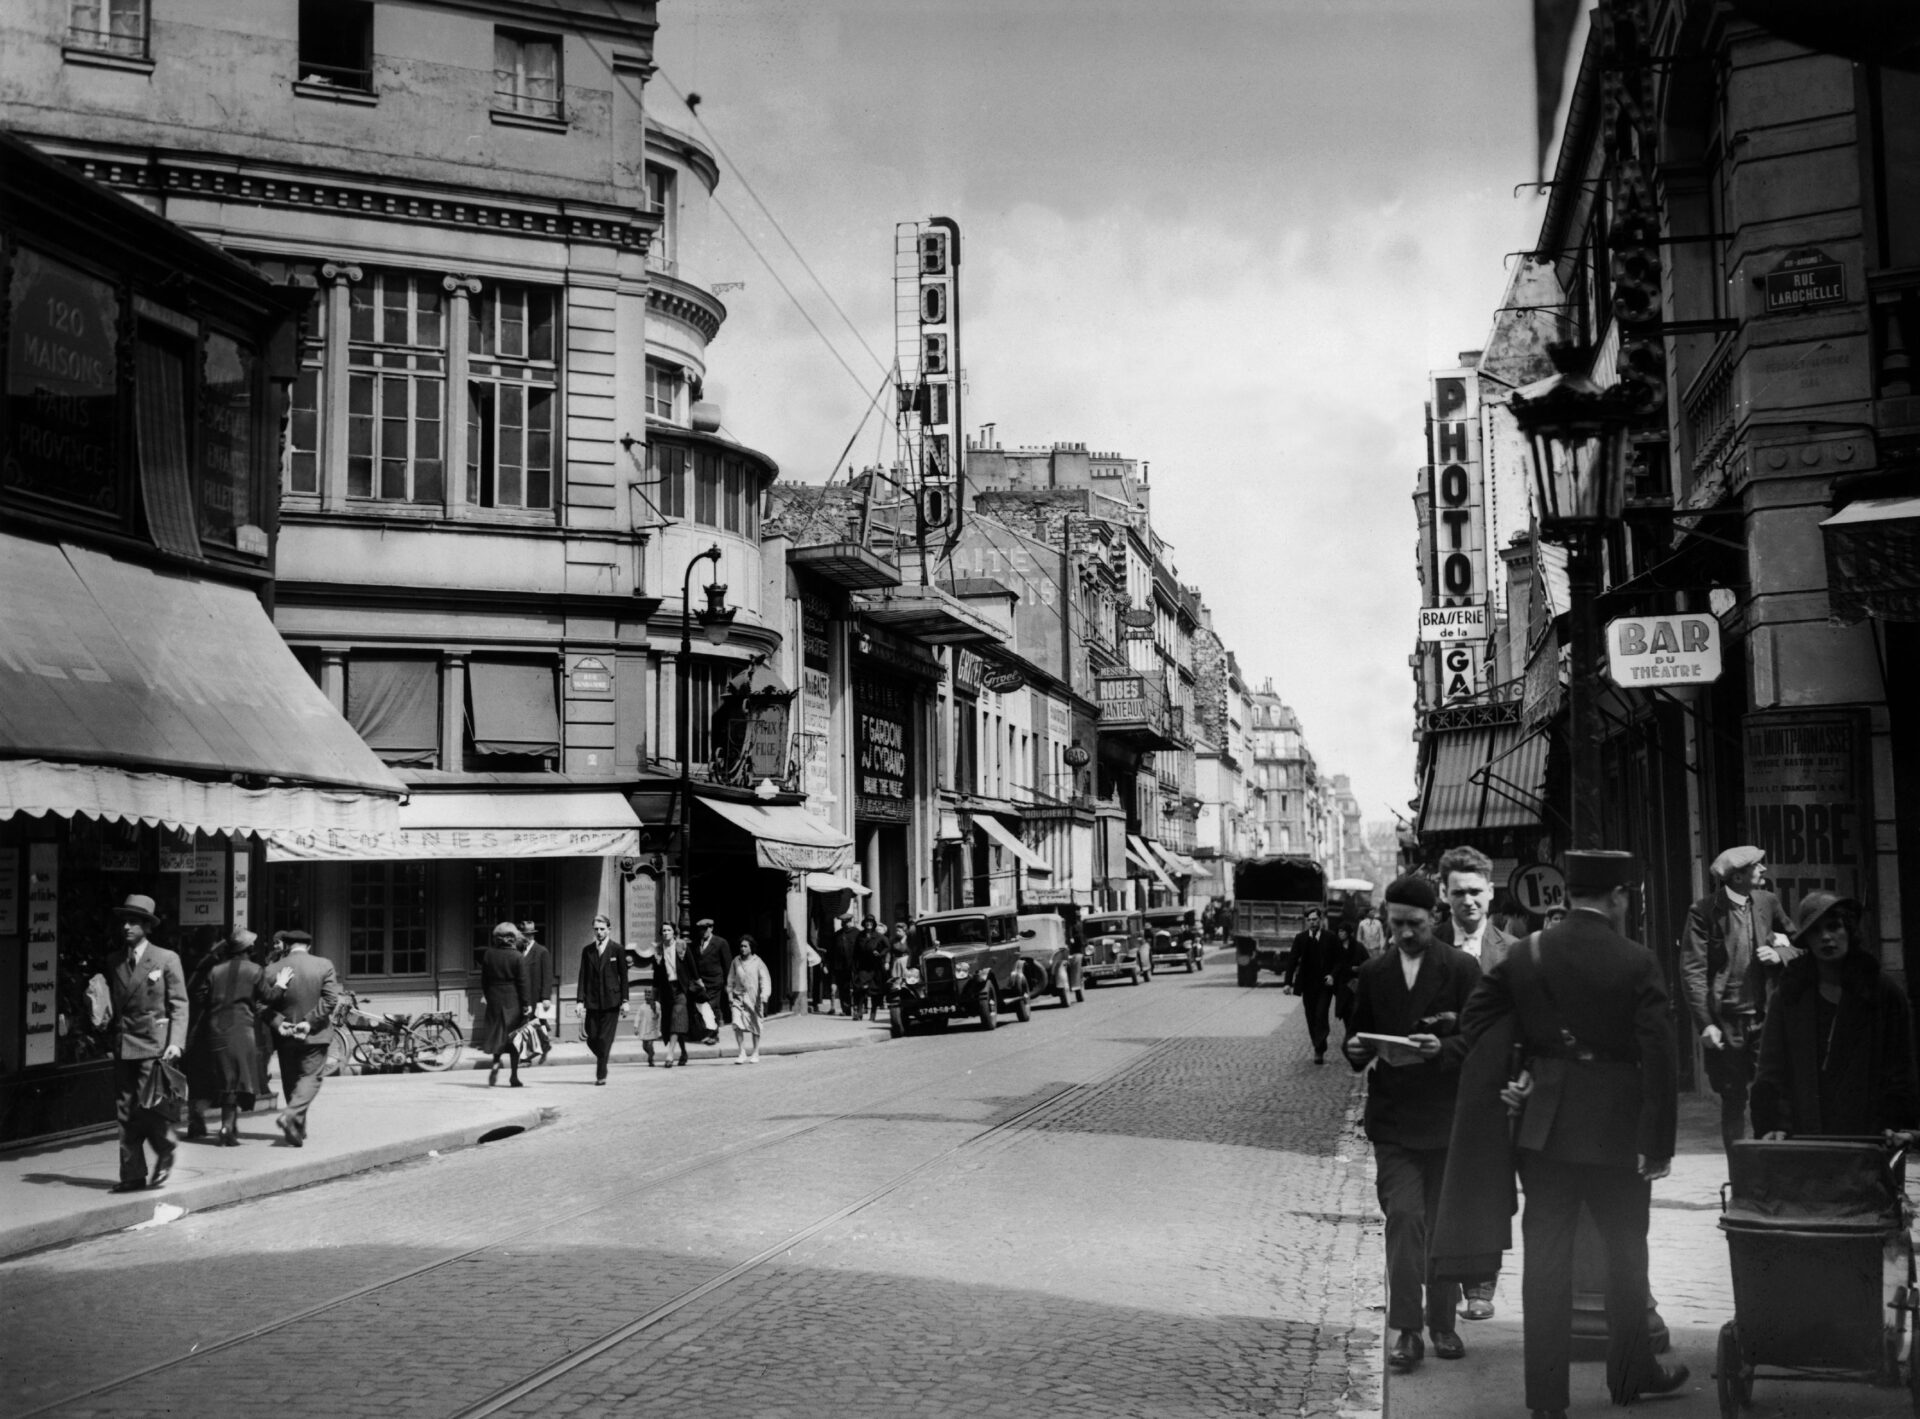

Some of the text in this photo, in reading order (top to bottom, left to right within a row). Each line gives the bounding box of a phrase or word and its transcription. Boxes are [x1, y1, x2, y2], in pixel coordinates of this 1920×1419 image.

[1793, 272, 1816, 287] RUE
[1771, 284, 1841, 306] LAROCHELLE
[47, 298, 84, 337] 120
[24, 332, 105, 389] MAISONS
[921, 233, 948, 527] BOBINO
[37, 385, 89, 428] PARIS
[20, 421, 104, 476] PROVINCE
[1436, 377, 1476, 606] PHOTO
[1422, 610, 1485, 627] BRASSERIE
[1440, 627, 1468, 638] de la
[1618, 619, 1710, 656] BAR
[1654, 656, 1676, 664] DU
[1100, 679, 1139, 700] ROBES
[1098, 700, 1145, 720] MANTEAUX
[1764, 726, 1851, 756] MONTPARNASSE
[1068, 749, 1086, 763] BAR
[195, 904, 209, 914] ICI
